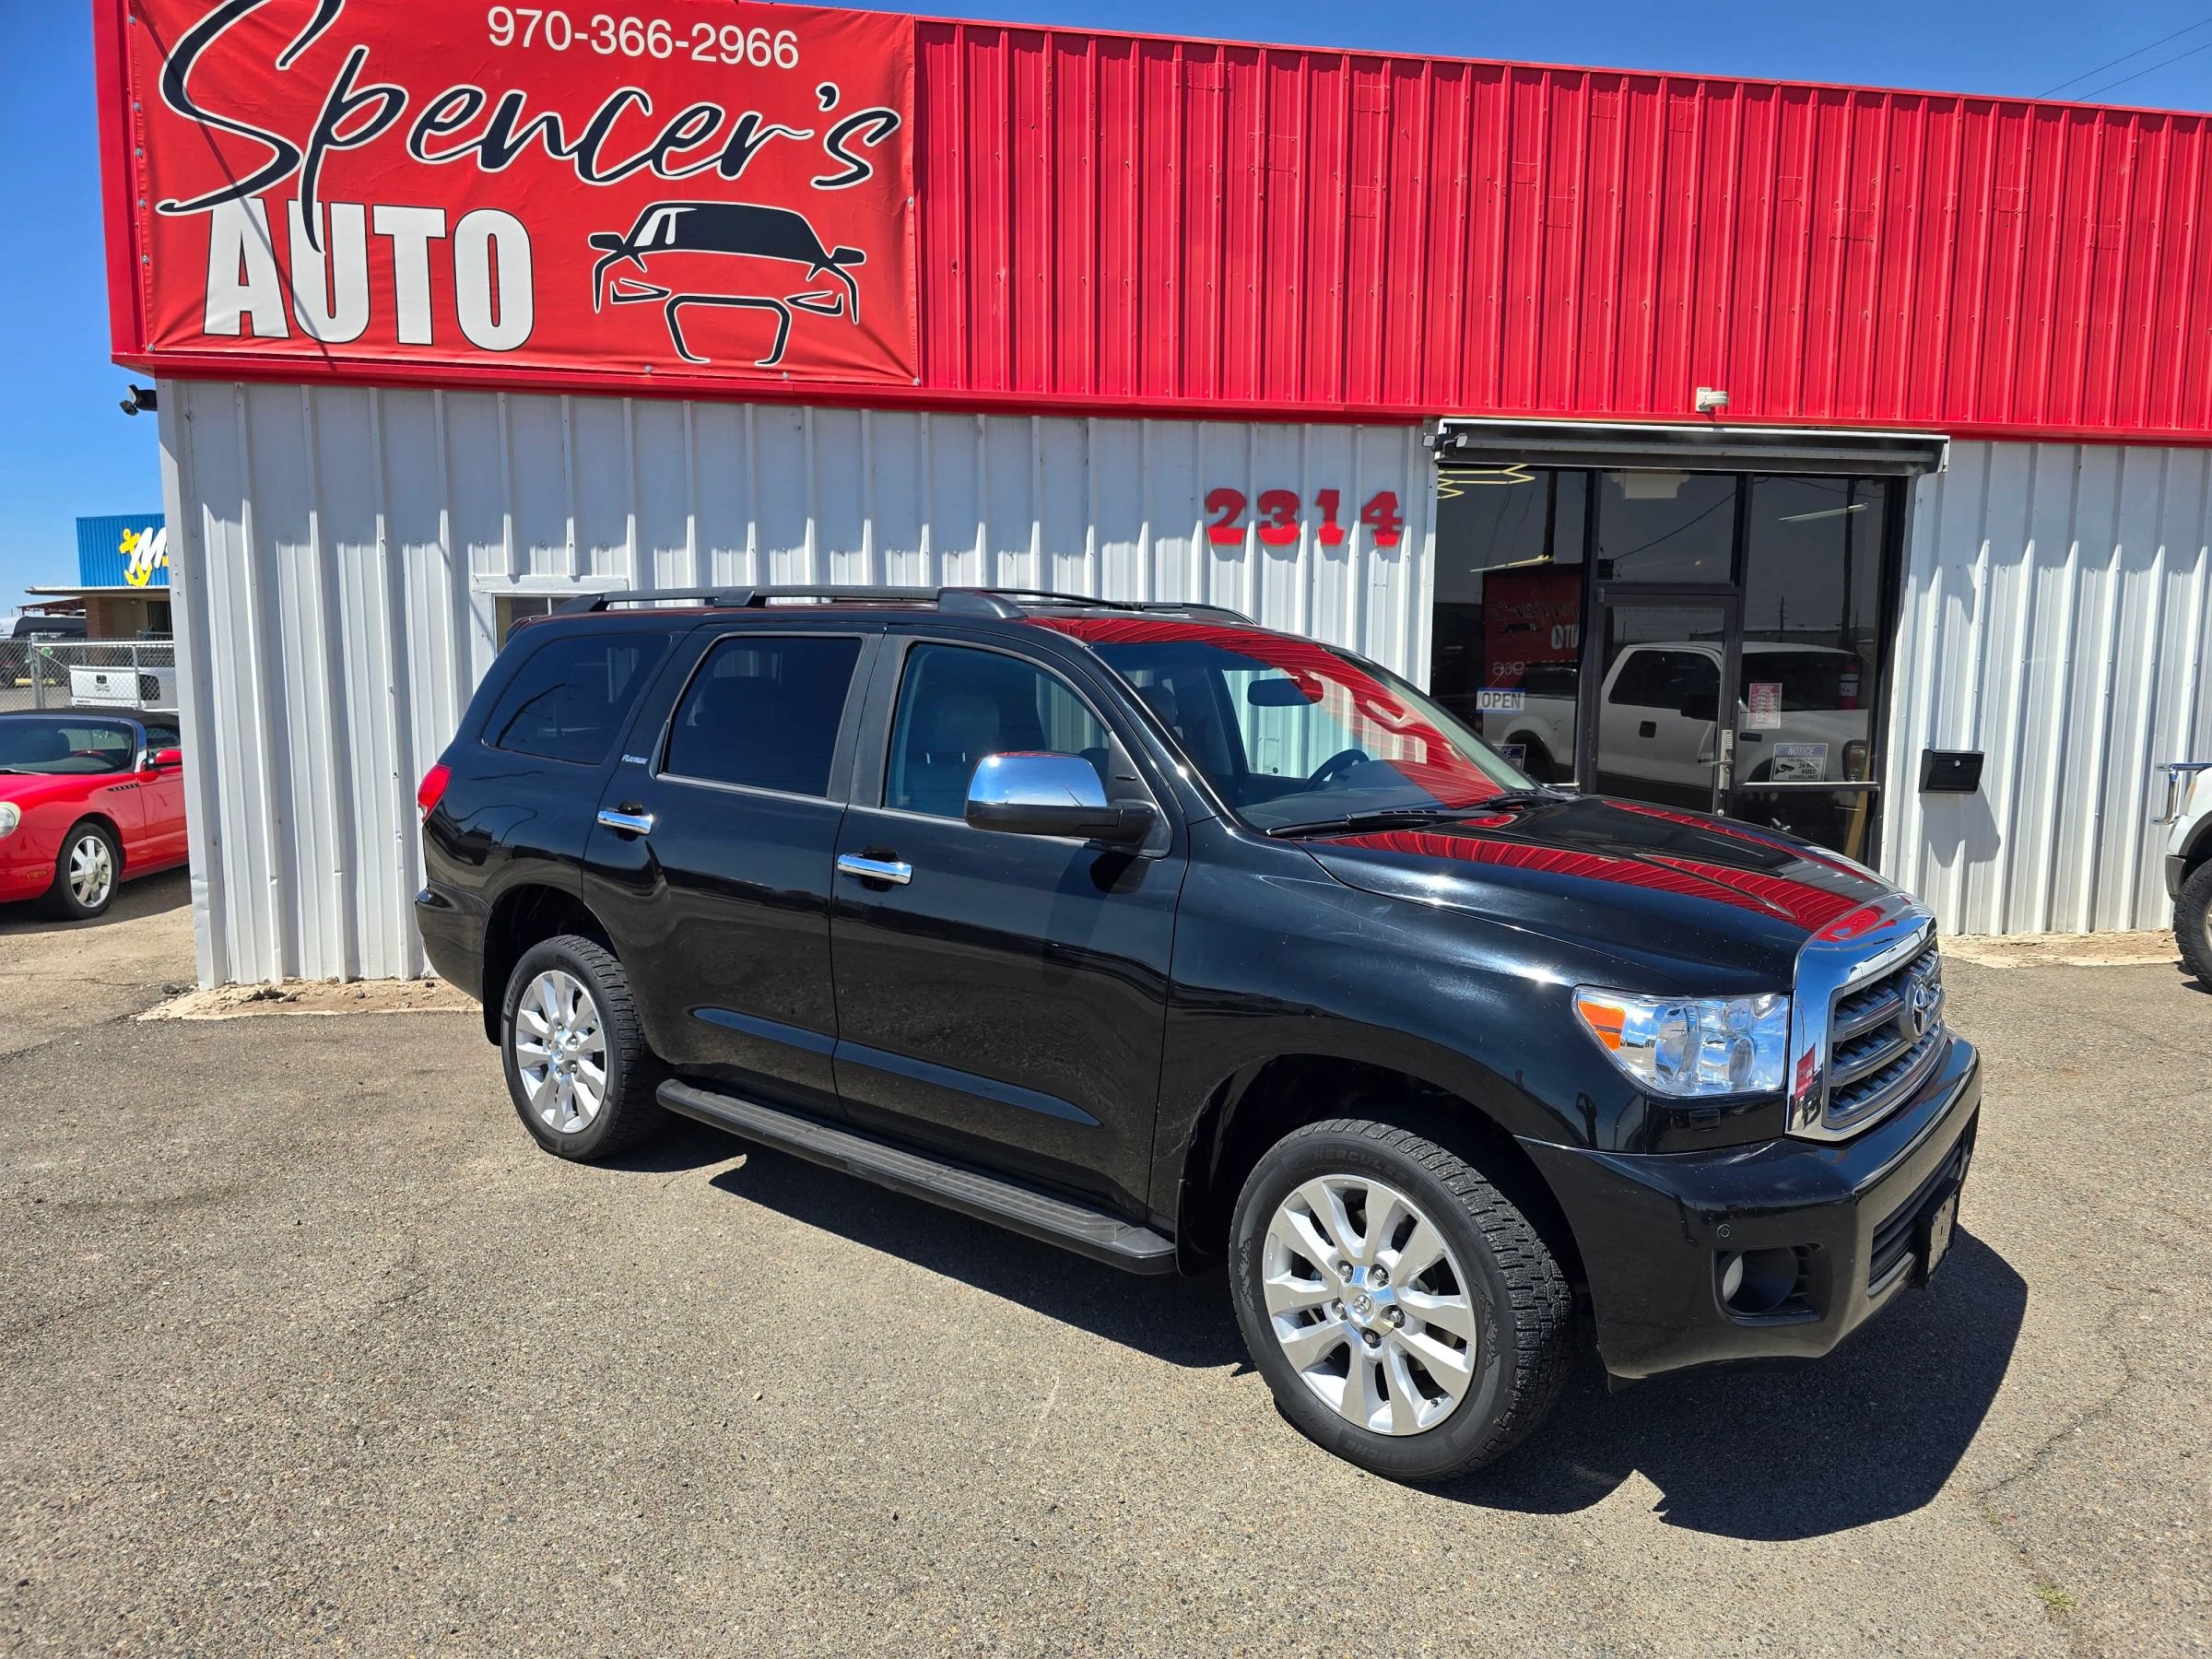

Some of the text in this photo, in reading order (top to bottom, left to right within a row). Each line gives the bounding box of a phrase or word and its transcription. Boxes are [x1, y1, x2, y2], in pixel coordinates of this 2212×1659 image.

[488, 6, 799, 69] 970-366-2966
[159, 0, 900, 255] Spencer's
[203, 196, 535, 352] AUTO
[1205, 488, 1404, 547] 2314
[1481, 691, 1521, 710] OPEN
[1788, 747, 1815, 756] NOTICE
